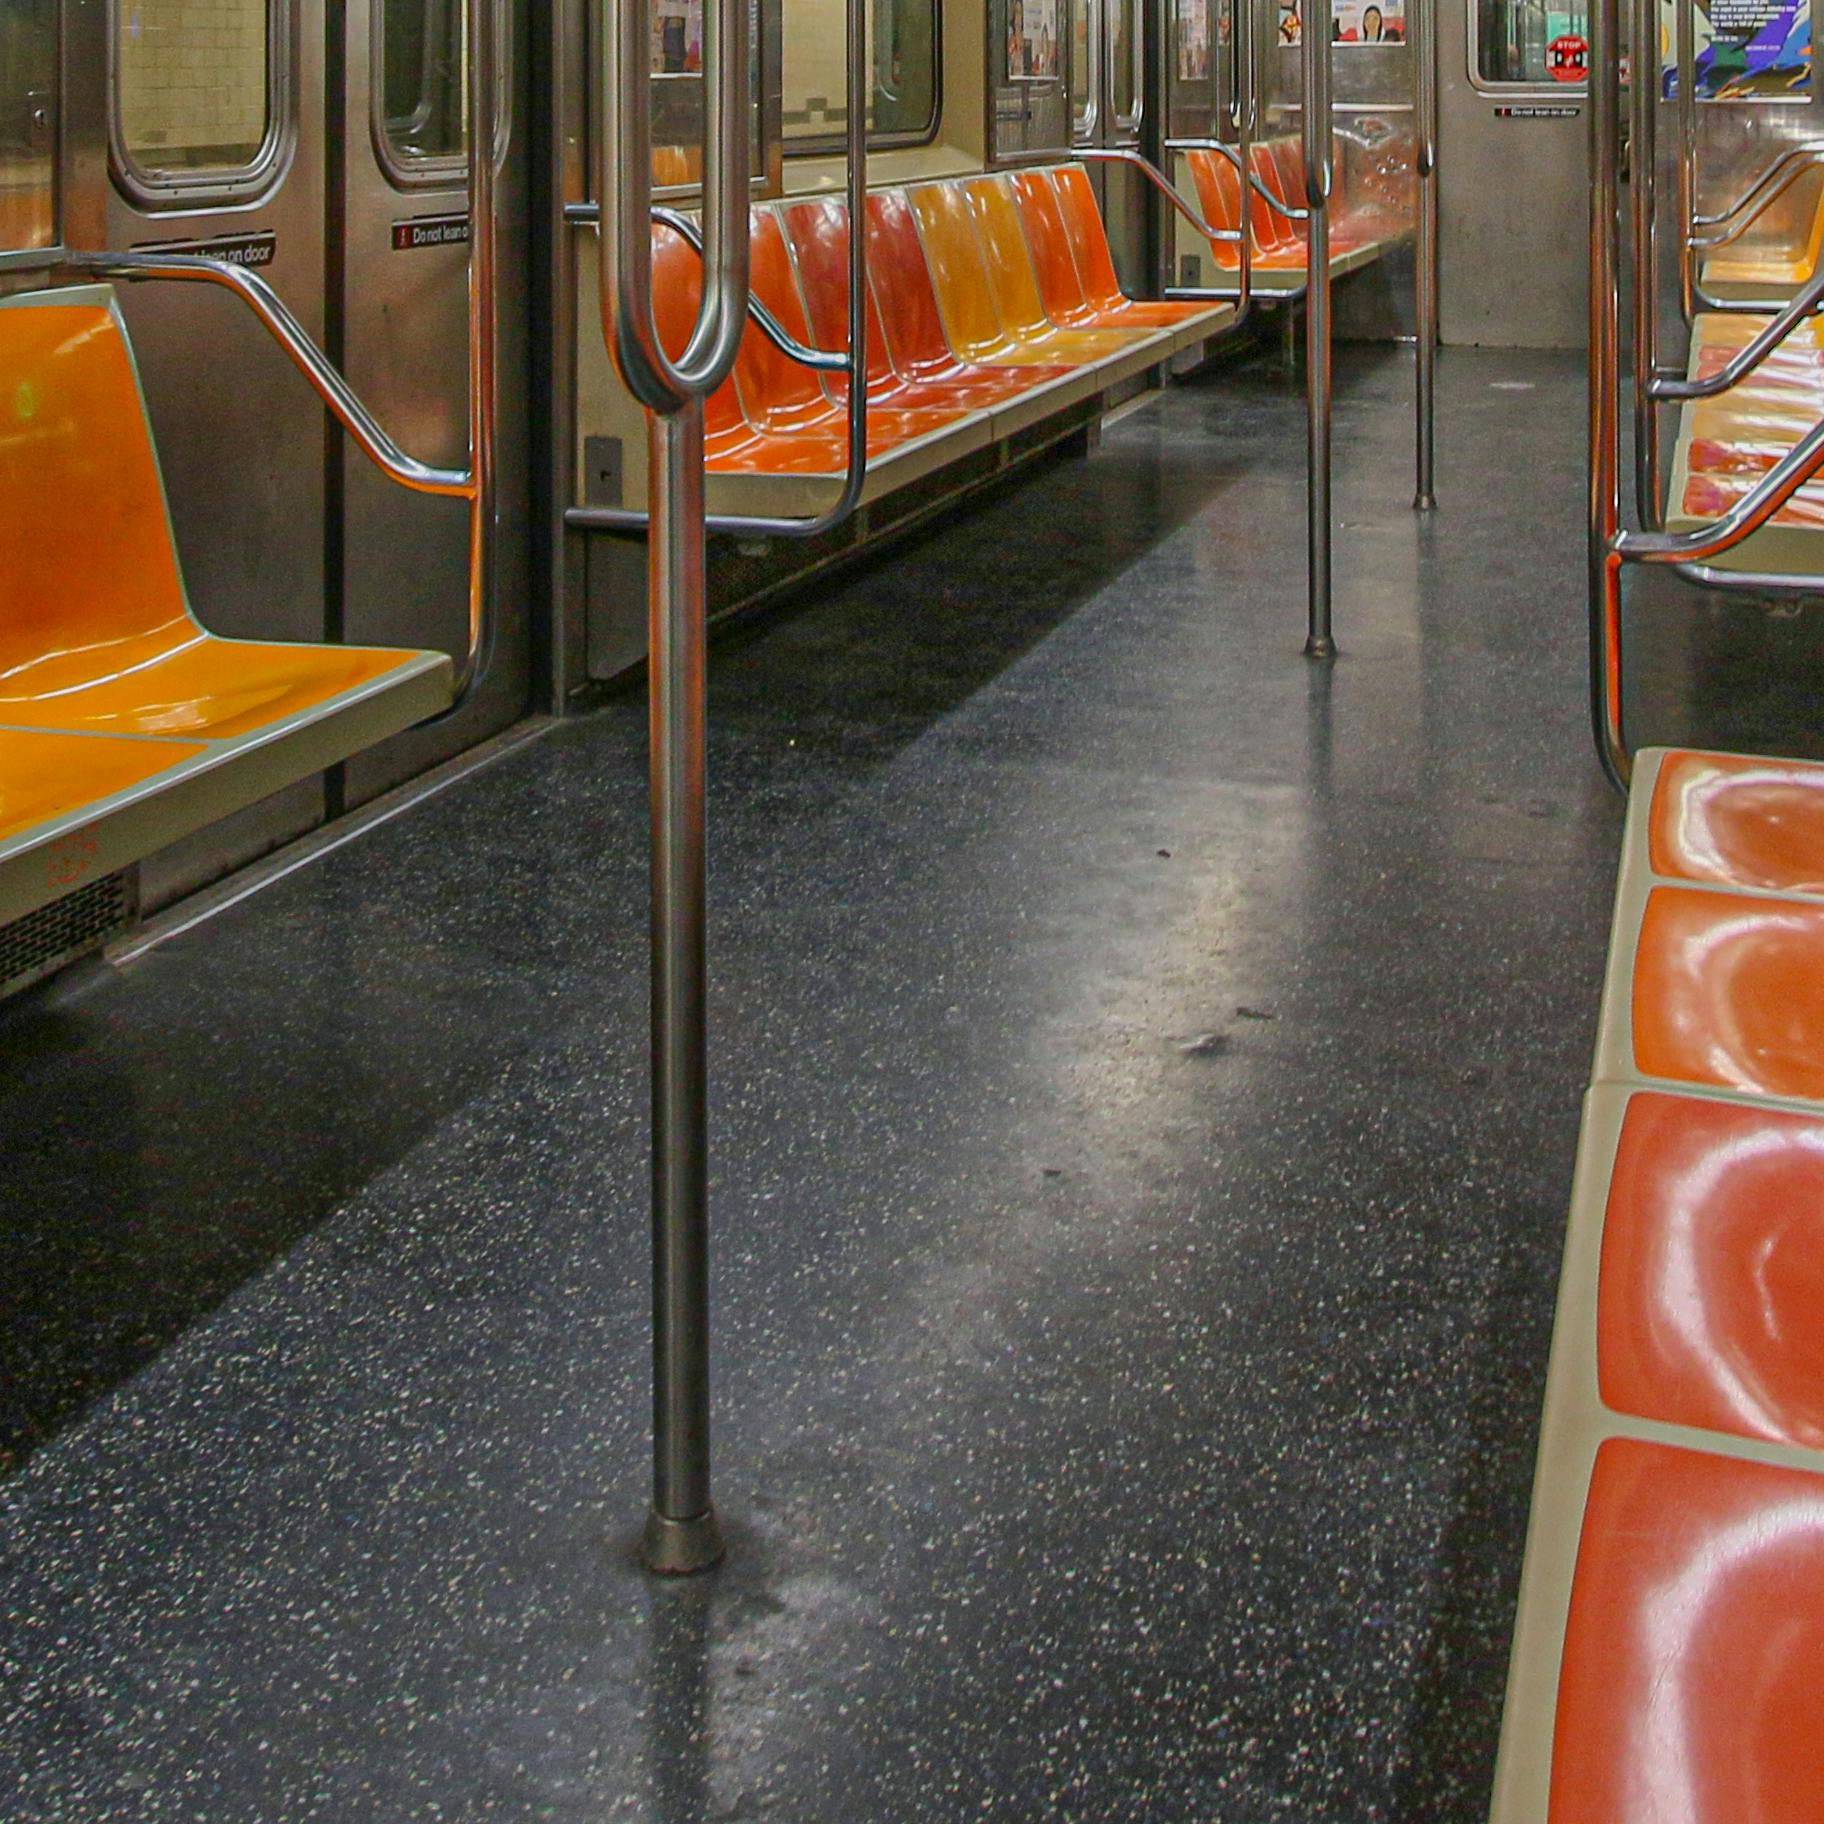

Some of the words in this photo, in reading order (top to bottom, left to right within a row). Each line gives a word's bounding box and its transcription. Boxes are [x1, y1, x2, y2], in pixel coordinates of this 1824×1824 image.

[1557, 41, 1582, 50] STOP
[413, 228, 425, 243] Do
[427, 226, 442, 241] not
[228, 248, 242, 262] on
[244, 243, 272, 262] door
